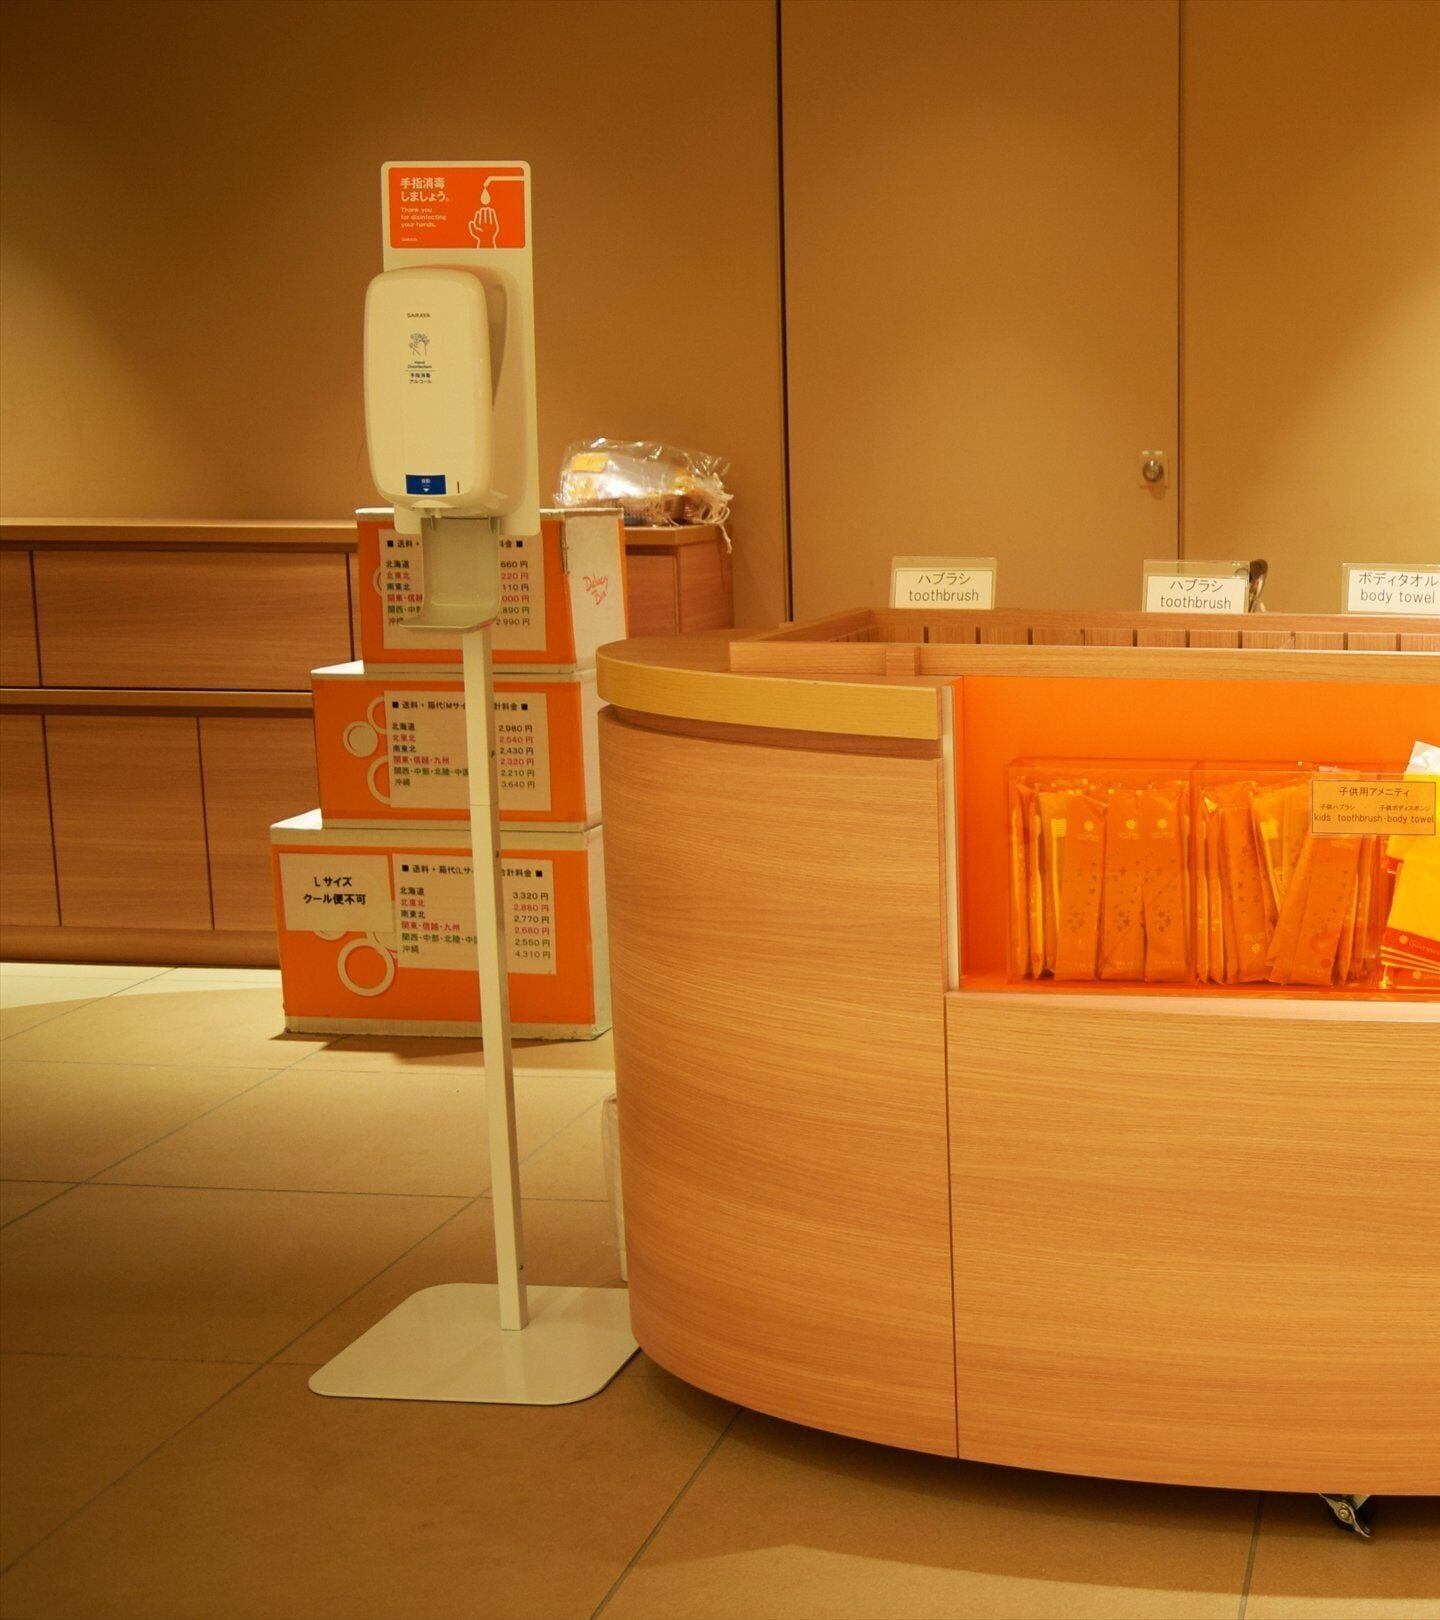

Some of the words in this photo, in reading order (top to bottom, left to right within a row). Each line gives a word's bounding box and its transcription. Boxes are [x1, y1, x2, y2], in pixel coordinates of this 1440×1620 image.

[400, 177, 445, 189] 手指消毒
[401, 191, 449, 202] しましょう。
[386, 560, 410, 569] 北海道
[520, 560, 529, 569] 円
[386, 572, 411, 580] 北東北
[520, 573, 529, 581] 円
[918, 573, 971, 586] ハブラシ
[1358, 571, 1439, 587] ボディタオル
[386, 583, 411, 591] 南東北
[521, 584, 529, 592] 円
[1170, 579, 1224, 593] ハブラシ
[521, 595, 530, 603] 円
[908, 587, 979, 603] toothbrush
[1360, 589, 1393, 605] body
[1399, 590, 1436, 604] towel
[1160, 594, 1232, 610] toothbrush
[521, 606, 530, 615] 円
[522, 618, 531, 627] 円
[402, 702, 419, 710] 送料
[392, 722, 415, 731] 北海道
[525, 724, 533, 733] 円
[392, 734, 416, 742] 北東北
[525, 736, 534, 744] 円
[392, 745, 416, 753] 南東北
[526, 747, 534, 756] 円
[526, 758, 535, 767] 円
[527, 769, 535, 778] 円
[394, 778, 411, 787] 沖縄
[527, 781, 536, 789] 円
[1339, 786, 1410, 798] 子供用アメニティ
[1320, 803, 1356, 811] 子供ハブラシ
[1313, 813, 1331, 822] kids
[1411, 814, 1435, 824] towel
[412, 865, 429, 873] 送料
[304, 893, 366, 906] クール便不可
[400, 887, 425, 896] 北海道
[540, 892, 549, 901] 円
[400, 899, 426, 907] 北東北
[541, 903, 550, 912] 円
[400, 910, 426, 919] 南東北
[541, 915, 550, 924] 円
[541, 927, 550, 935] 円
[542, 939, 551, 947] 円
[402, 945, 420, 954] 沖縄
[542, 951, 551, 959] 円
